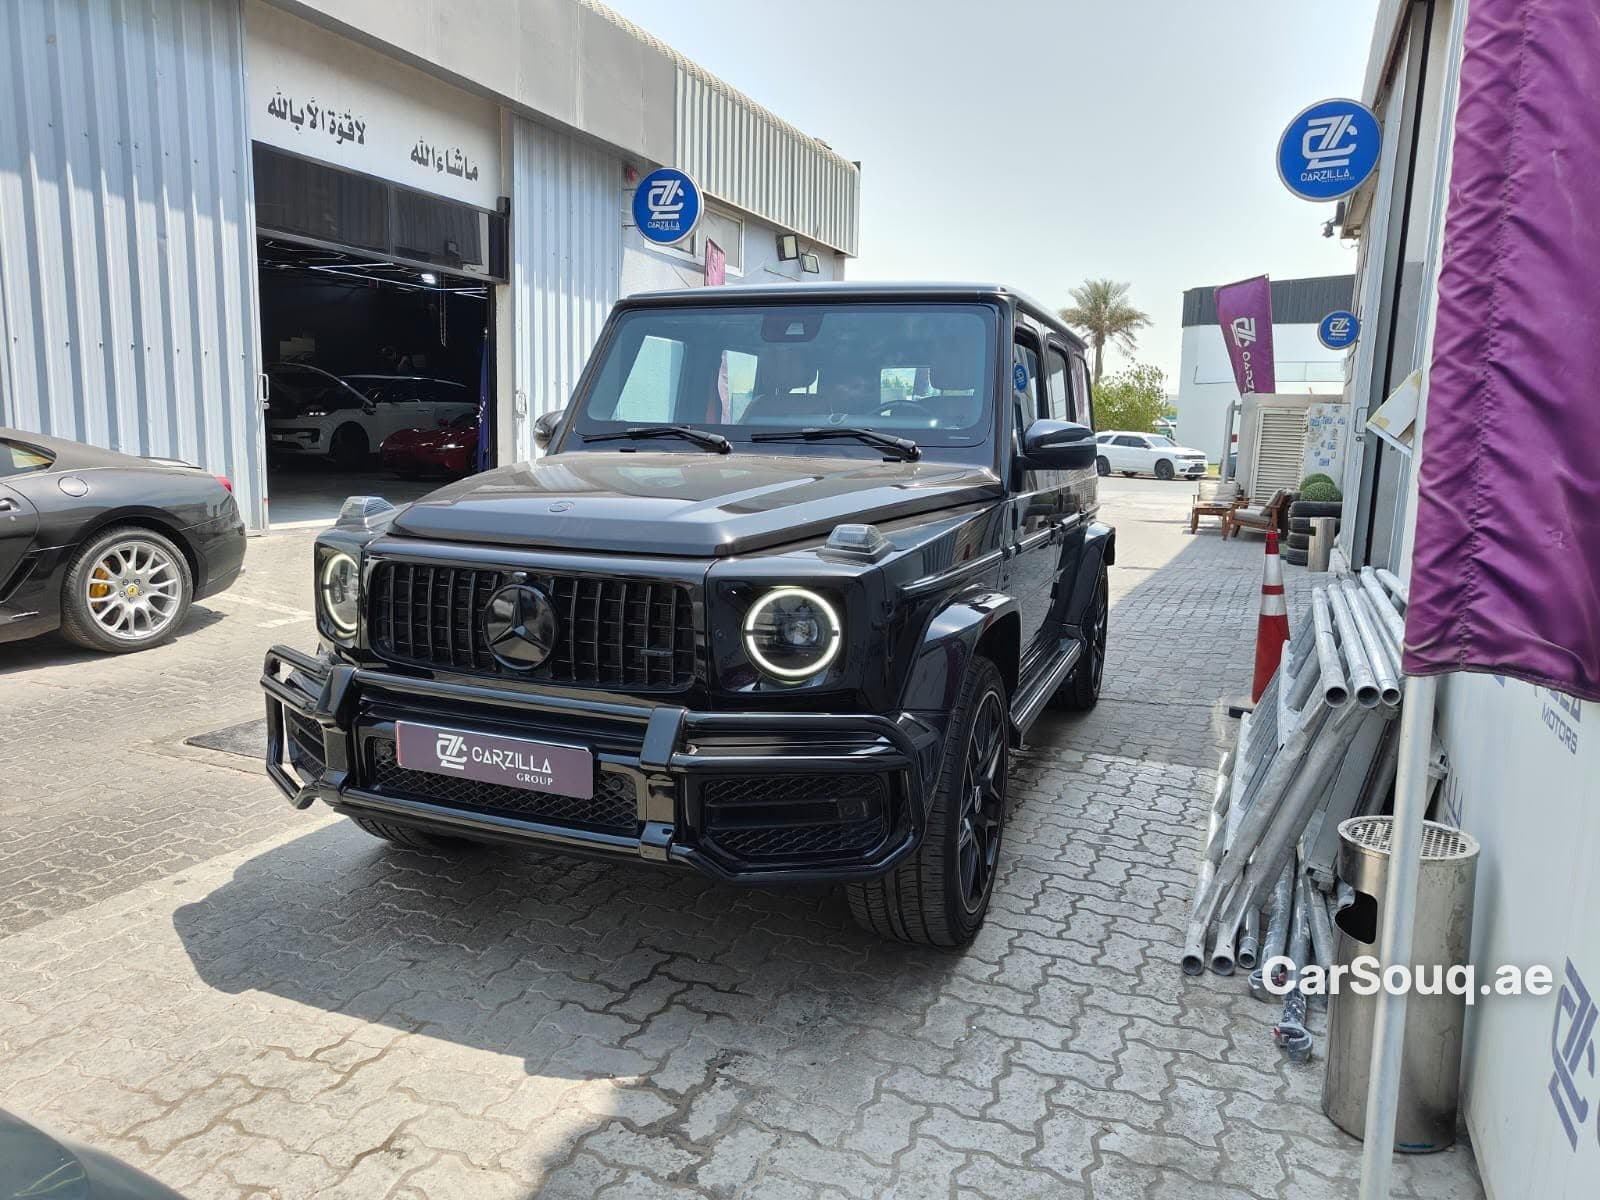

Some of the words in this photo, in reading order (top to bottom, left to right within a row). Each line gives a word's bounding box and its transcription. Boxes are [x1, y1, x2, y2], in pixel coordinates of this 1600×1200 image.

[1300, 168, 1350, 182] CARZILLA
[647, 221, 680, 231] CARZILLA
[1541, 702, 1578, 755] MOTORS
[472, 746, 552, 774] CARZILLA
[516, 772, 553, 786] GROUP
